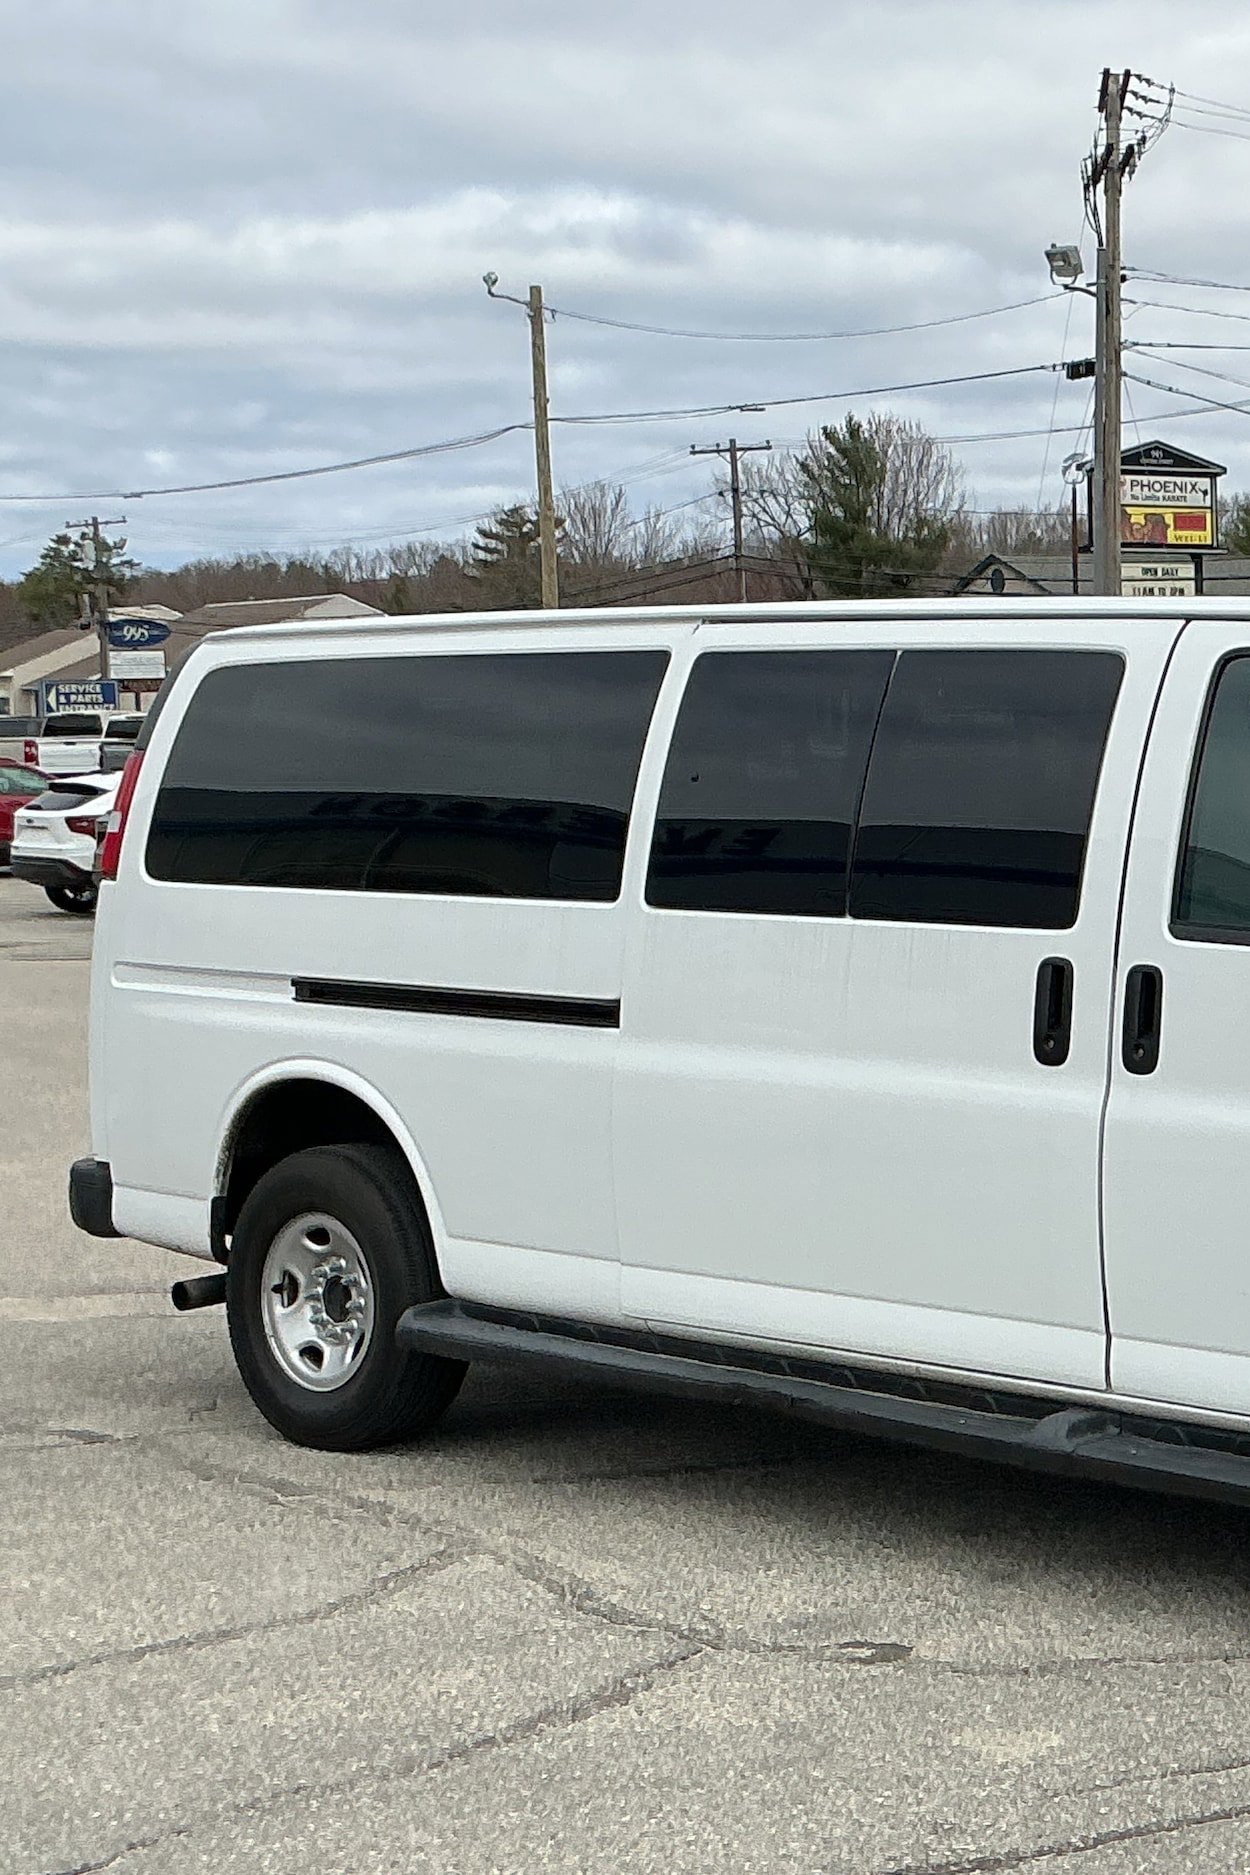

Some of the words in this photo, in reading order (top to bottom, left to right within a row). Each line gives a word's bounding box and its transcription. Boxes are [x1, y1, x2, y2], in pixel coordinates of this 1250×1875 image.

[1130, 480, 1199, 494] PHOENIX
[1141, 567, 1158, 577] OPEN
[58, 684, 102, 694] SERVICE
[70, 694, 104, 703] PARTS
